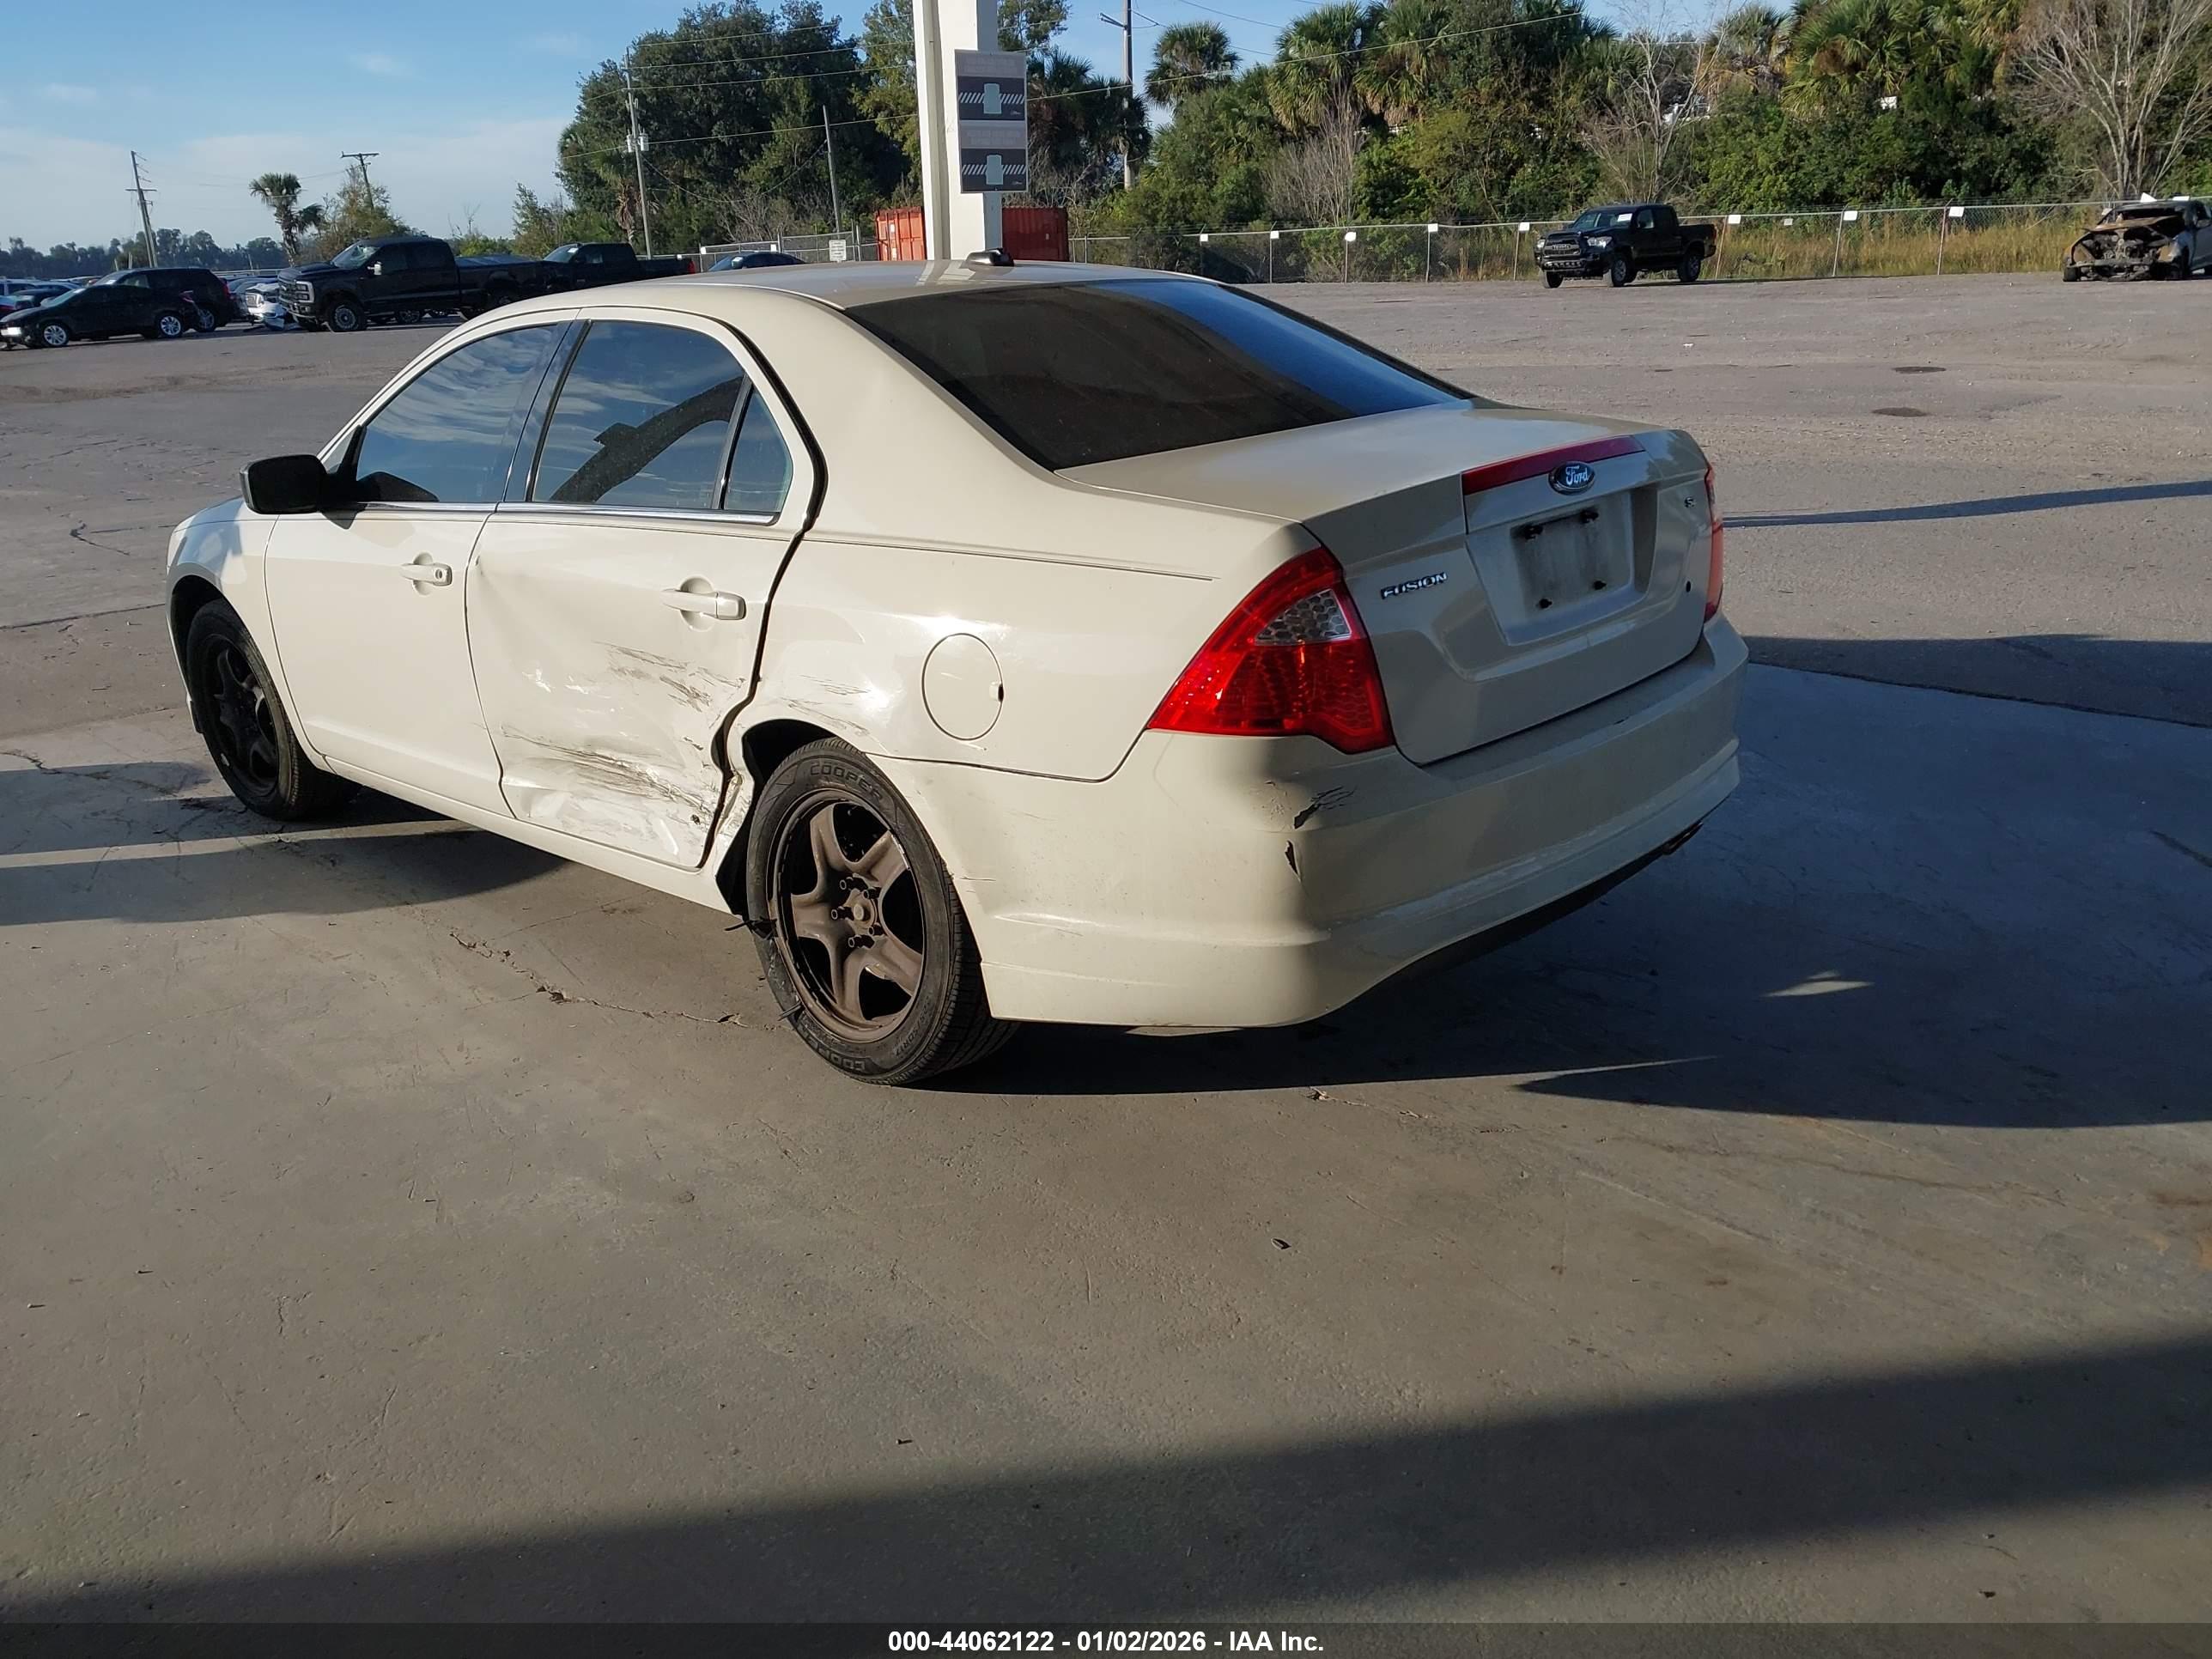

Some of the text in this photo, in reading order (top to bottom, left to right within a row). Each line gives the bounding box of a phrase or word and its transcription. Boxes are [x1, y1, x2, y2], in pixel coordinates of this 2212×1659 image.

[1565, 465, 1589, 486] Ford
[1380, 572, 1448, 600] FUSION
[810, 763, 883, 799] COOPER
